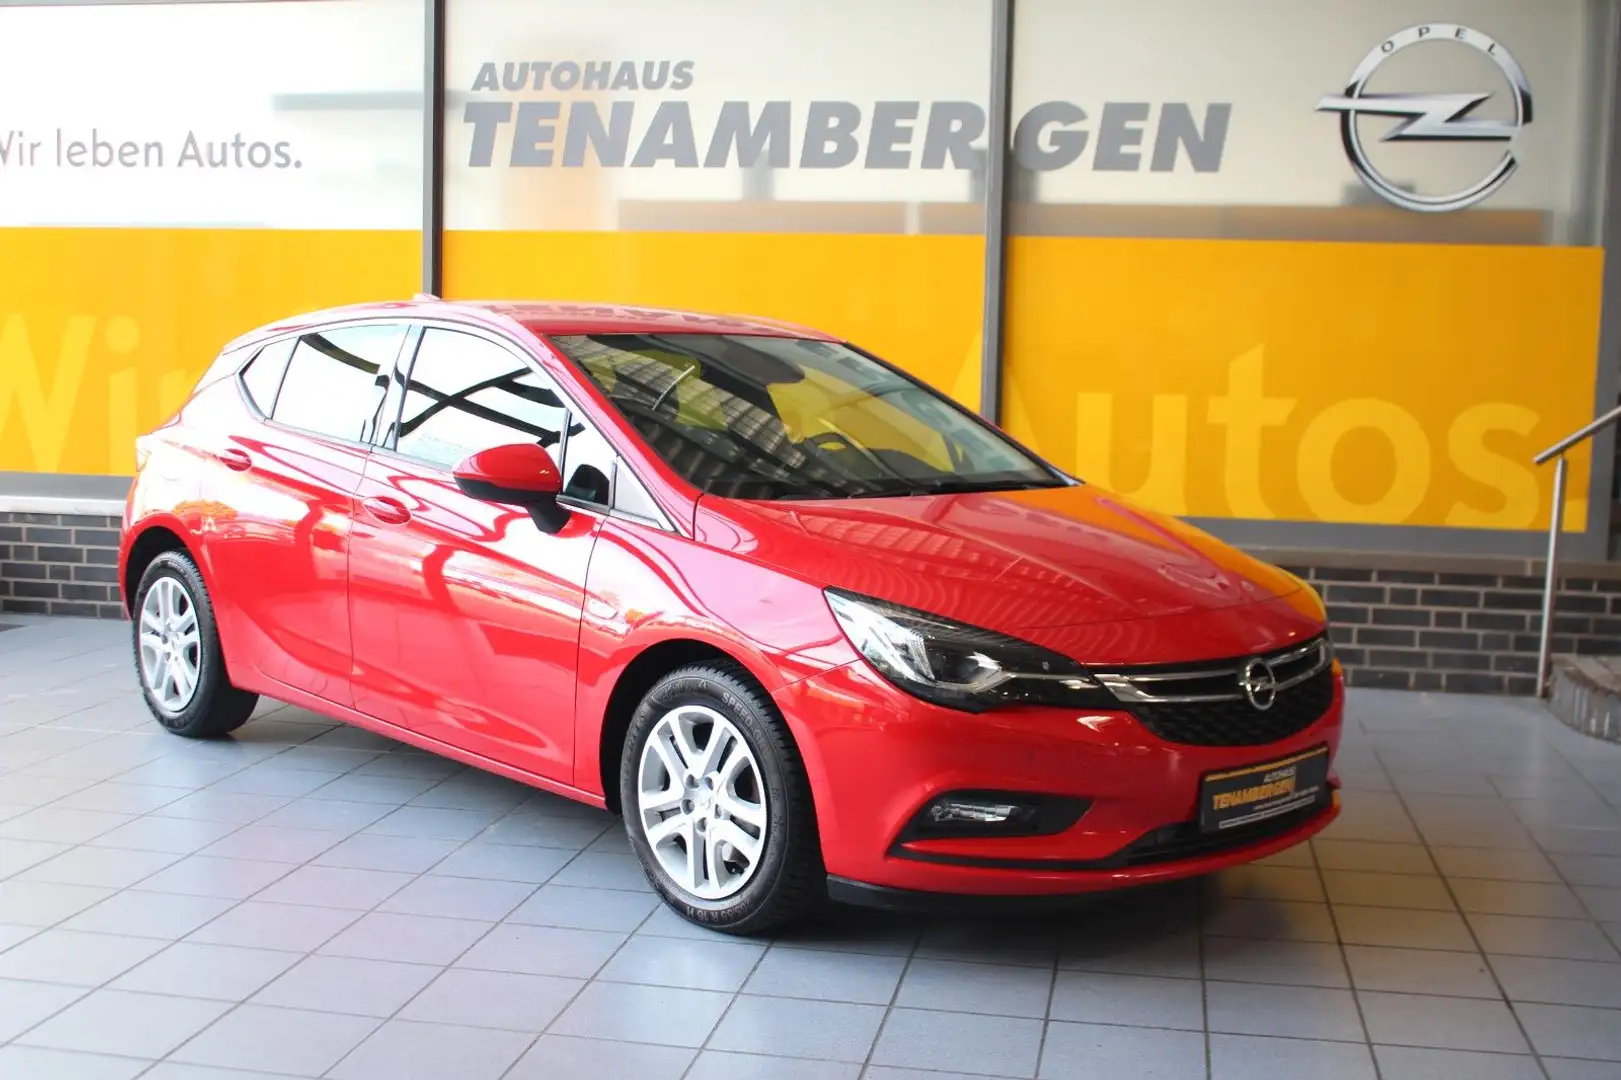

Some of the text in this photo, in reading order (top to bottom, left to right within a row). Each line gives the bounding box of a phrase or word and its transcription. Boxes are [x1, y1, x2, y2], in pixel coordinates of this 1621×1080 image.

[1381, 26, 1499, 56] OPEL
[472, 60, 694, 93] AUTOHAUS
[56, 128, 164, 168] leben
[177, 130, 303, 169] Autos.
[463, 99, 1233, 173] TENAMBERGEN
